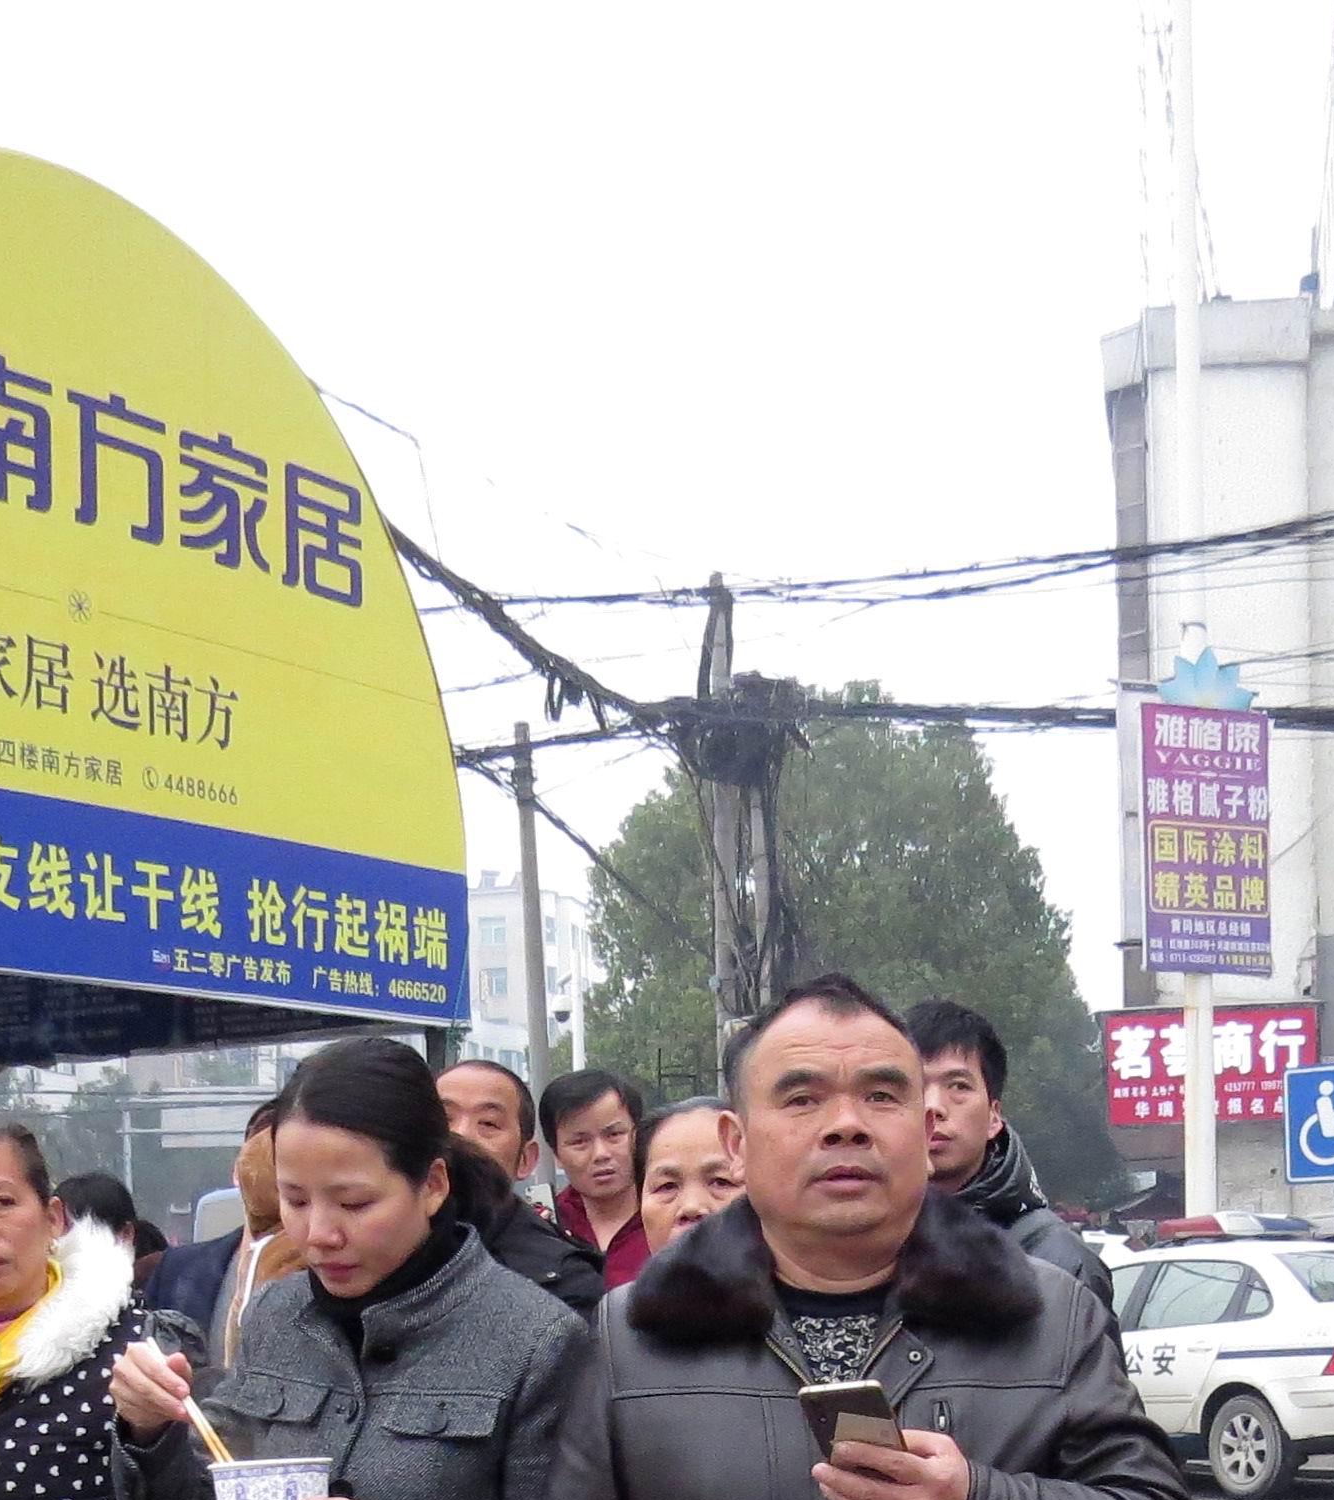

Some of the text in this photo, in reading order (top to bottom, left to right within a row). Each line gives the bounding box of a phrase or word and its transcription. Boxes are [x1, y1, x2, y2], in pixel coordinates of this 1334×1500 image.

[89, 651, 239, 750] 选南方
[1155, 749, 1263, 772] YAGGIE
[163, 773, 239, 806] 4488666
[1154, 827, 1265, 869] 国际涂料
[1154, 871, 1266, 912] 精英品牌
[247, 878, 450, 972] 抢行起祸端
[172, 949, 292, 988] 五二零广告发布
[1124, 1342, 1177, 1377] 公安
